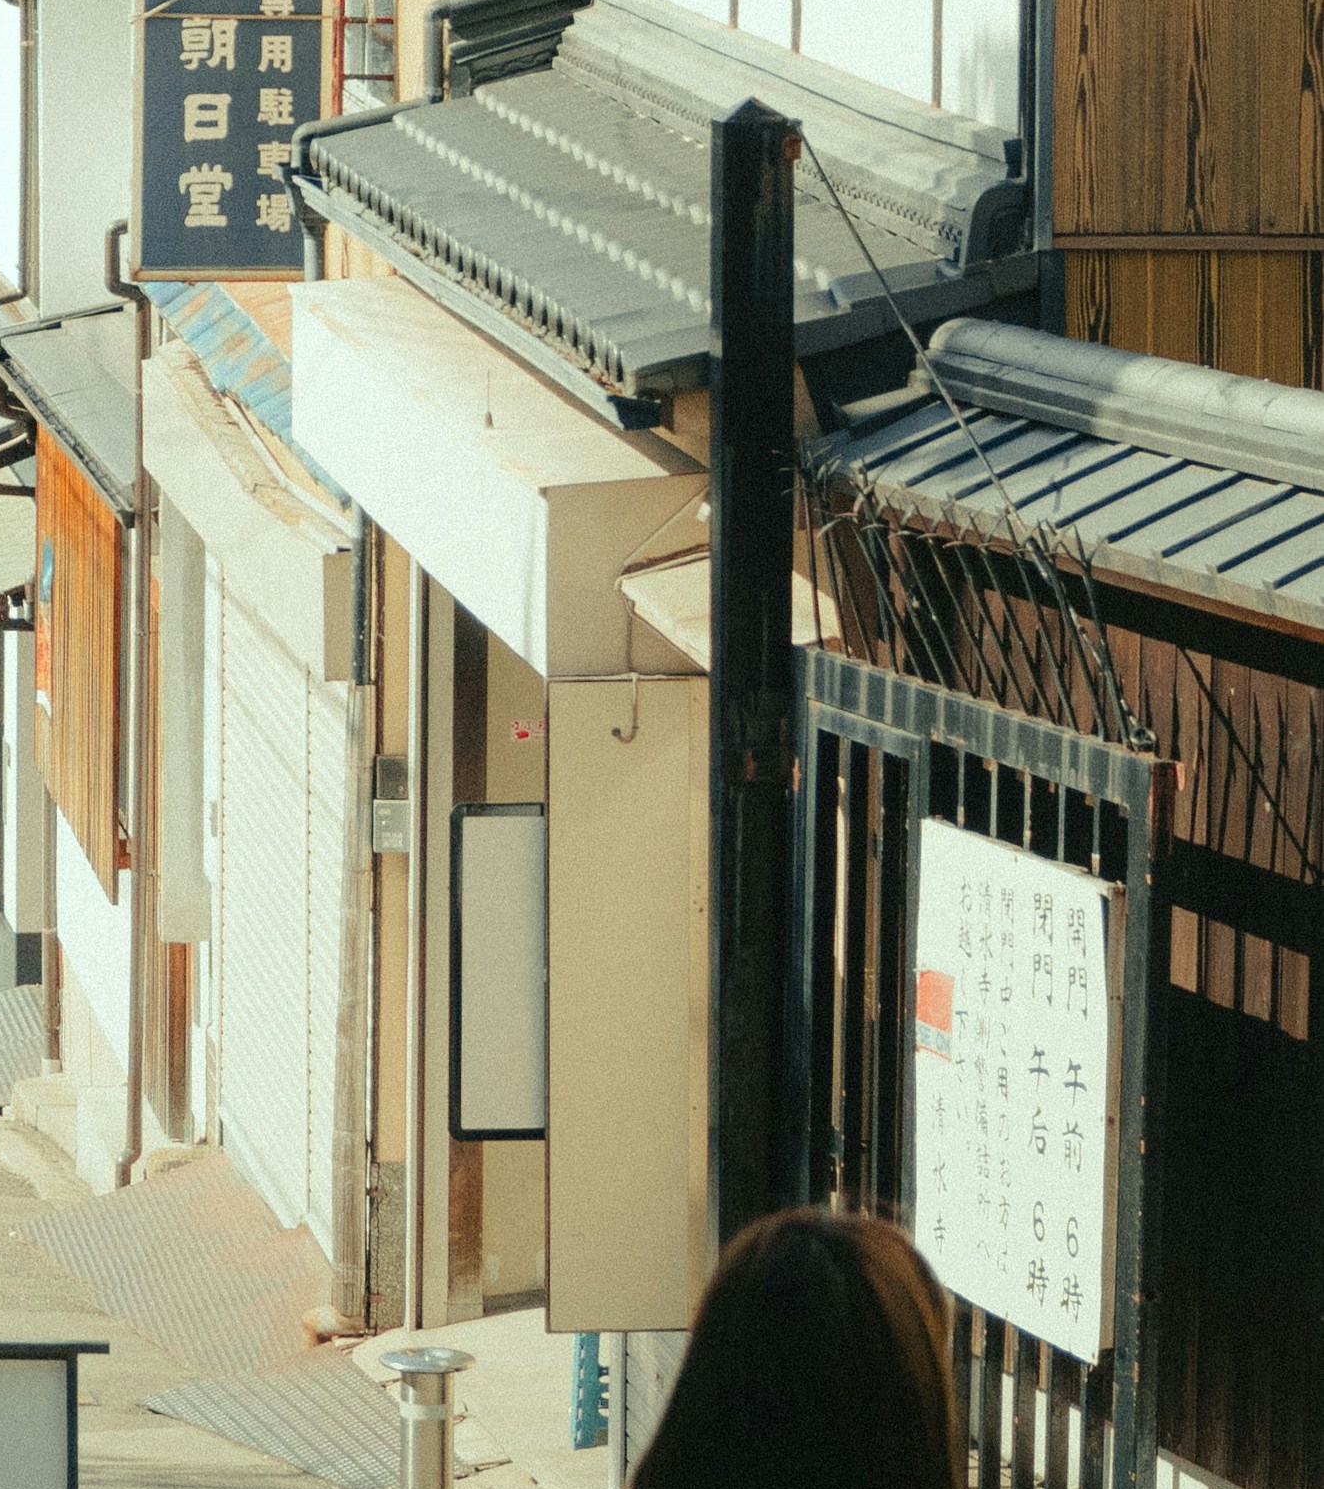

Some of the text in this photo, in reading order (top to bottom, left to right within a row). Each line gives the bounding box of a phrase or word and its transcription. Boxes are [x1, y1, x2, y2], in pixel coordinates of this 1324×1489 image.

[179, 19, 234, 228] 朝日堂
[1062, 1057, 1088, 1175] 午前
